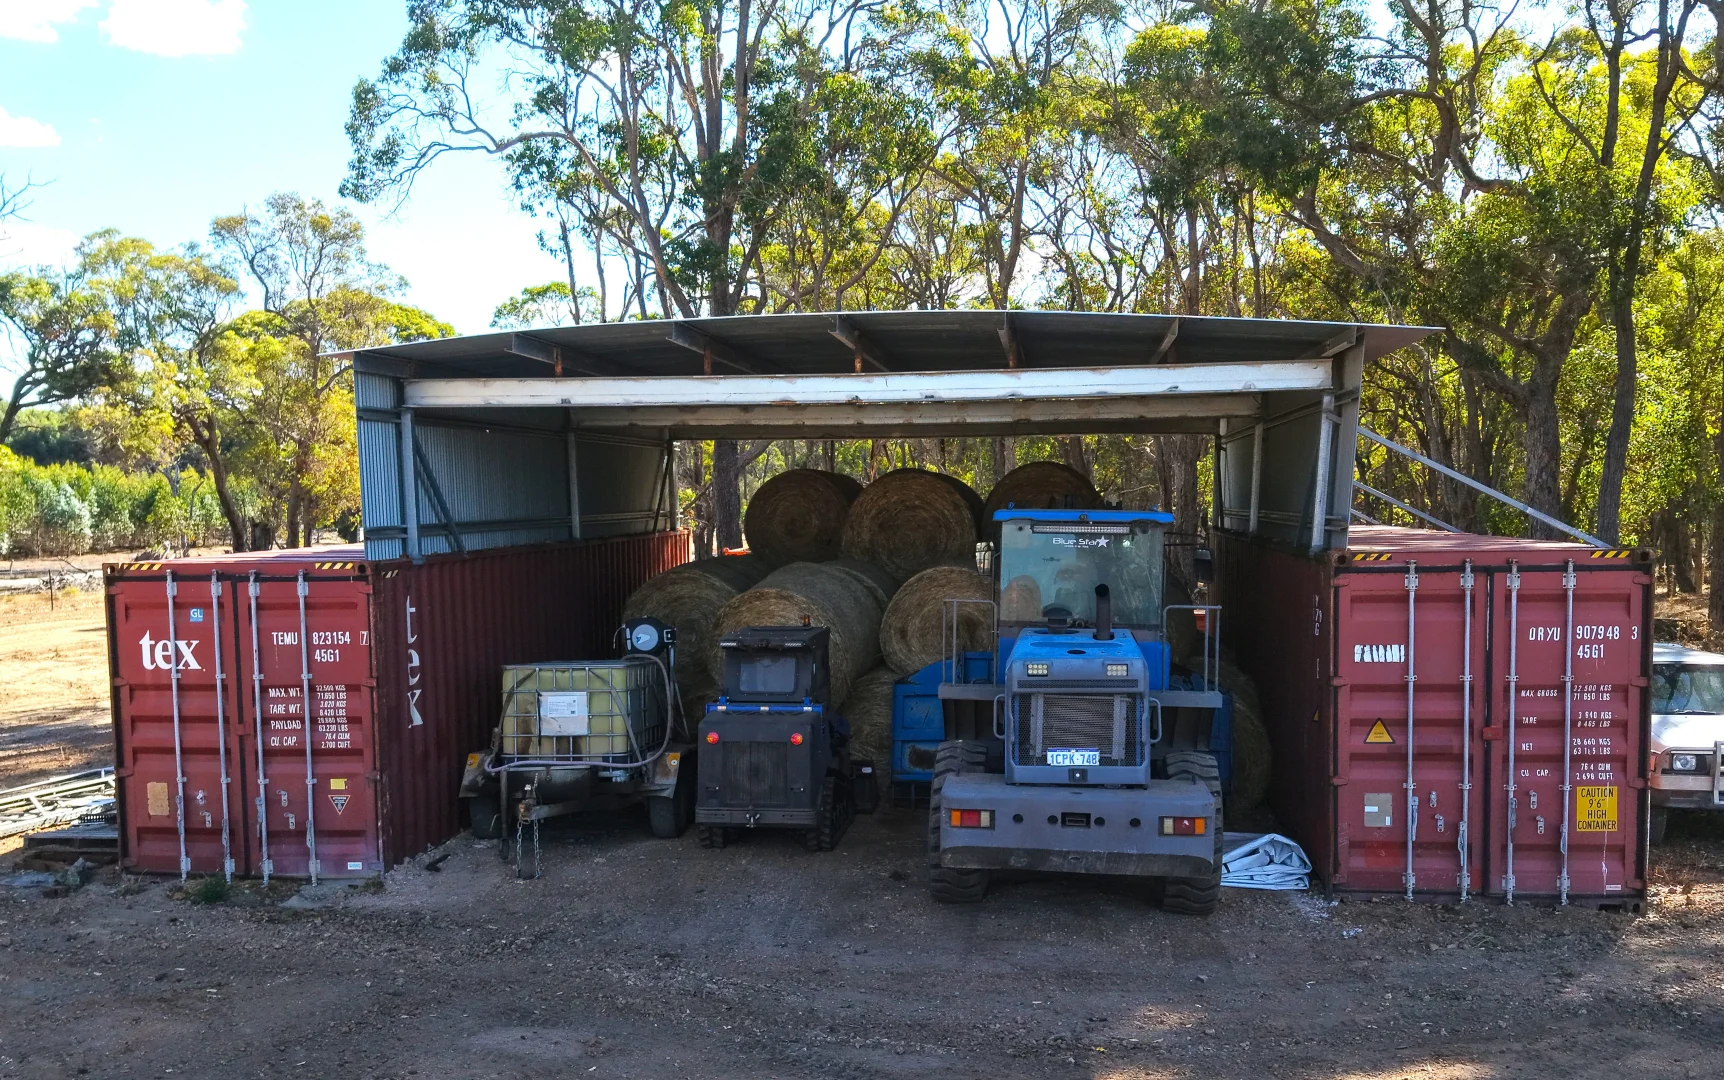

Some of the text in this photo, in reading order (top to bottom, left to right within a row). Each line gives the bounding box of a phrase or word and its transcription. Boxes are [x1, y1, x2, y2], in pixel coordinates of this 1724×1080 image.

[190, 608, 203, 618] GL
[272, 631, 368, 645] TEMU 823154 7
[1529, 626, 1638, 641] DRYU 907948 3
[314, 649, 340, 662] 45G1
[1576, 644, 1604, 658] 45G1
[270, 704, 286, 714] TARE
[270, 720, 302, 730] PAYLOAD
[1581, 788, 1614, 798] CAUTION
[1588, 810, 1606, 819] HIGH
[1577, 820, 1616, 830] CONTAINER
